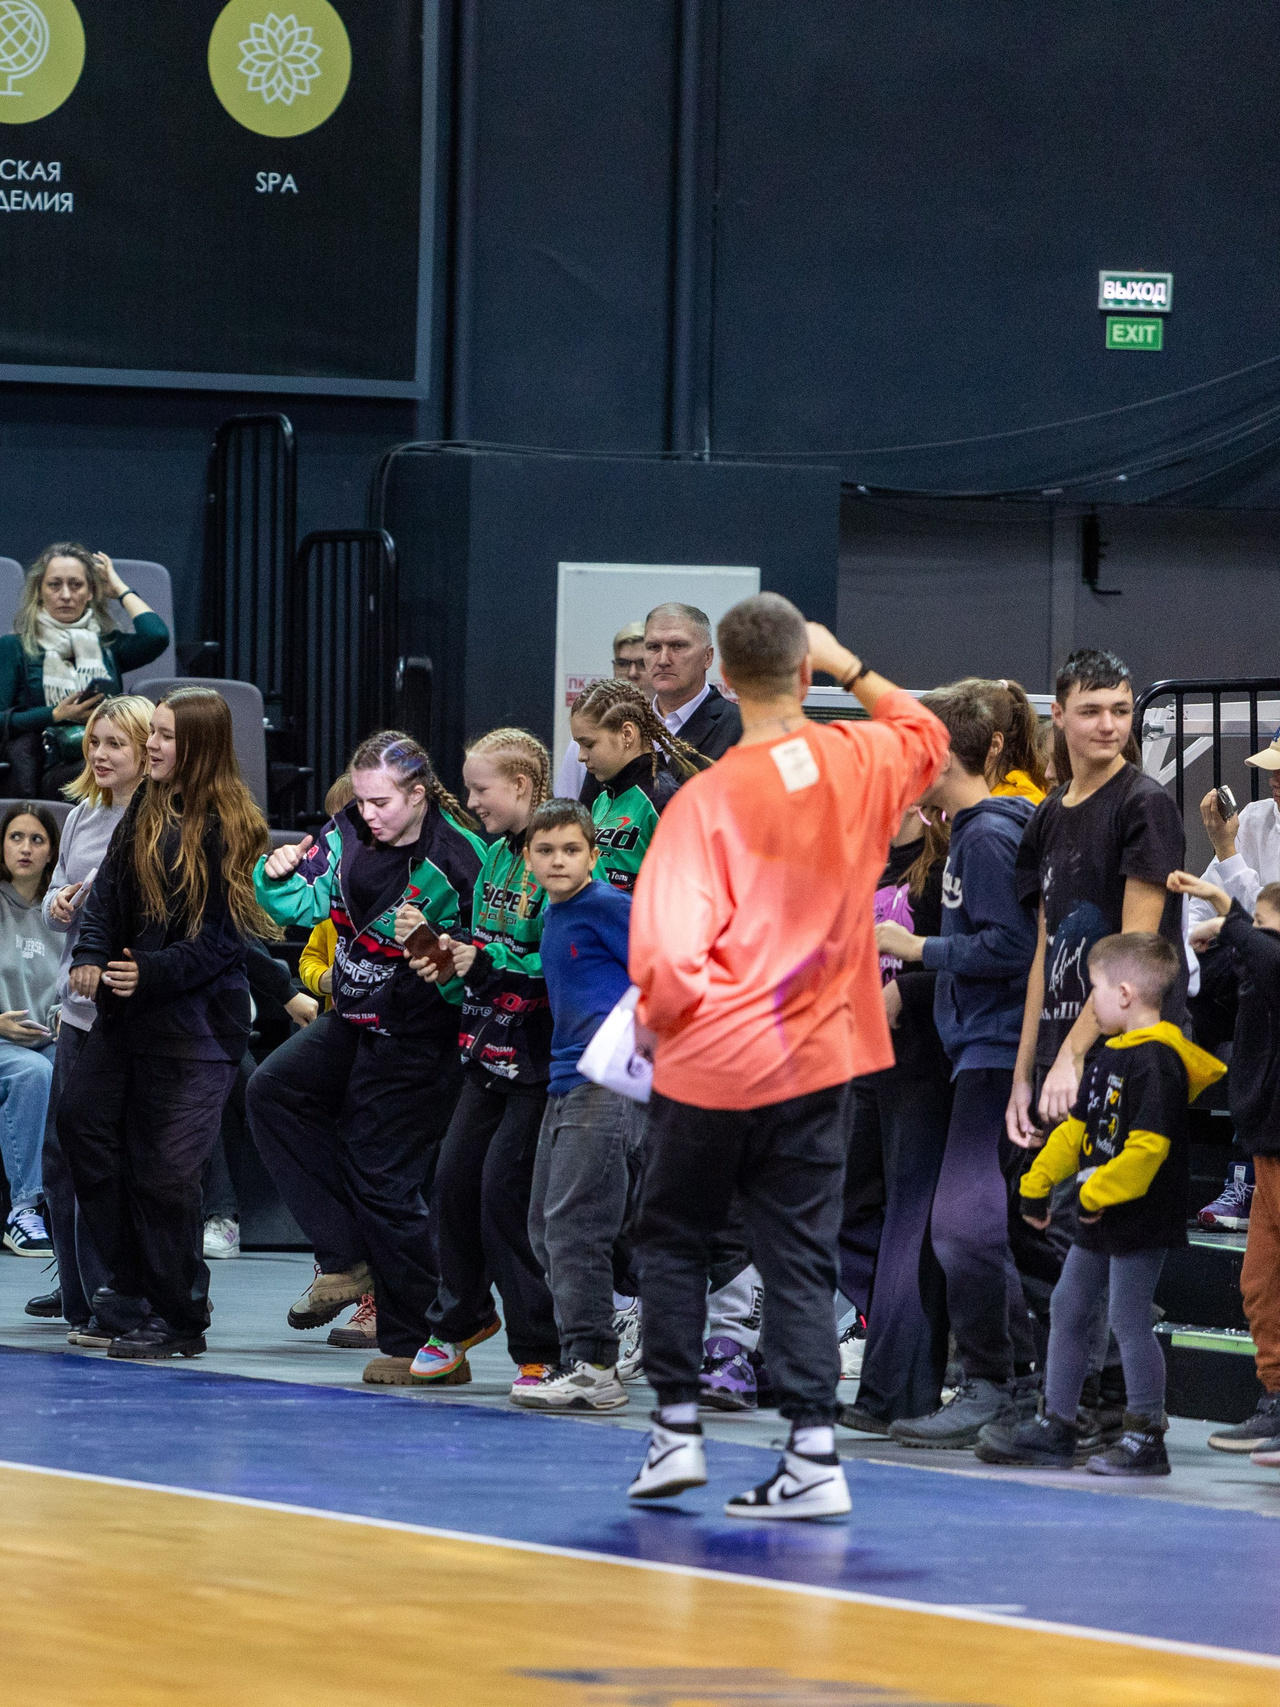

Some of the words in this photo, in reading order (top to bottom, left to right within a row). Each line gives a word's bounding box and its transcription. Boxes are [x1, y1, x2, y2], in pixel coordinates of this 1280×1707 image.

[254, 171, 299, 194] SPA
[1103, 280, 1166, 304] ВЫХОД
[1112, 324, 1156, 343] EXIT
